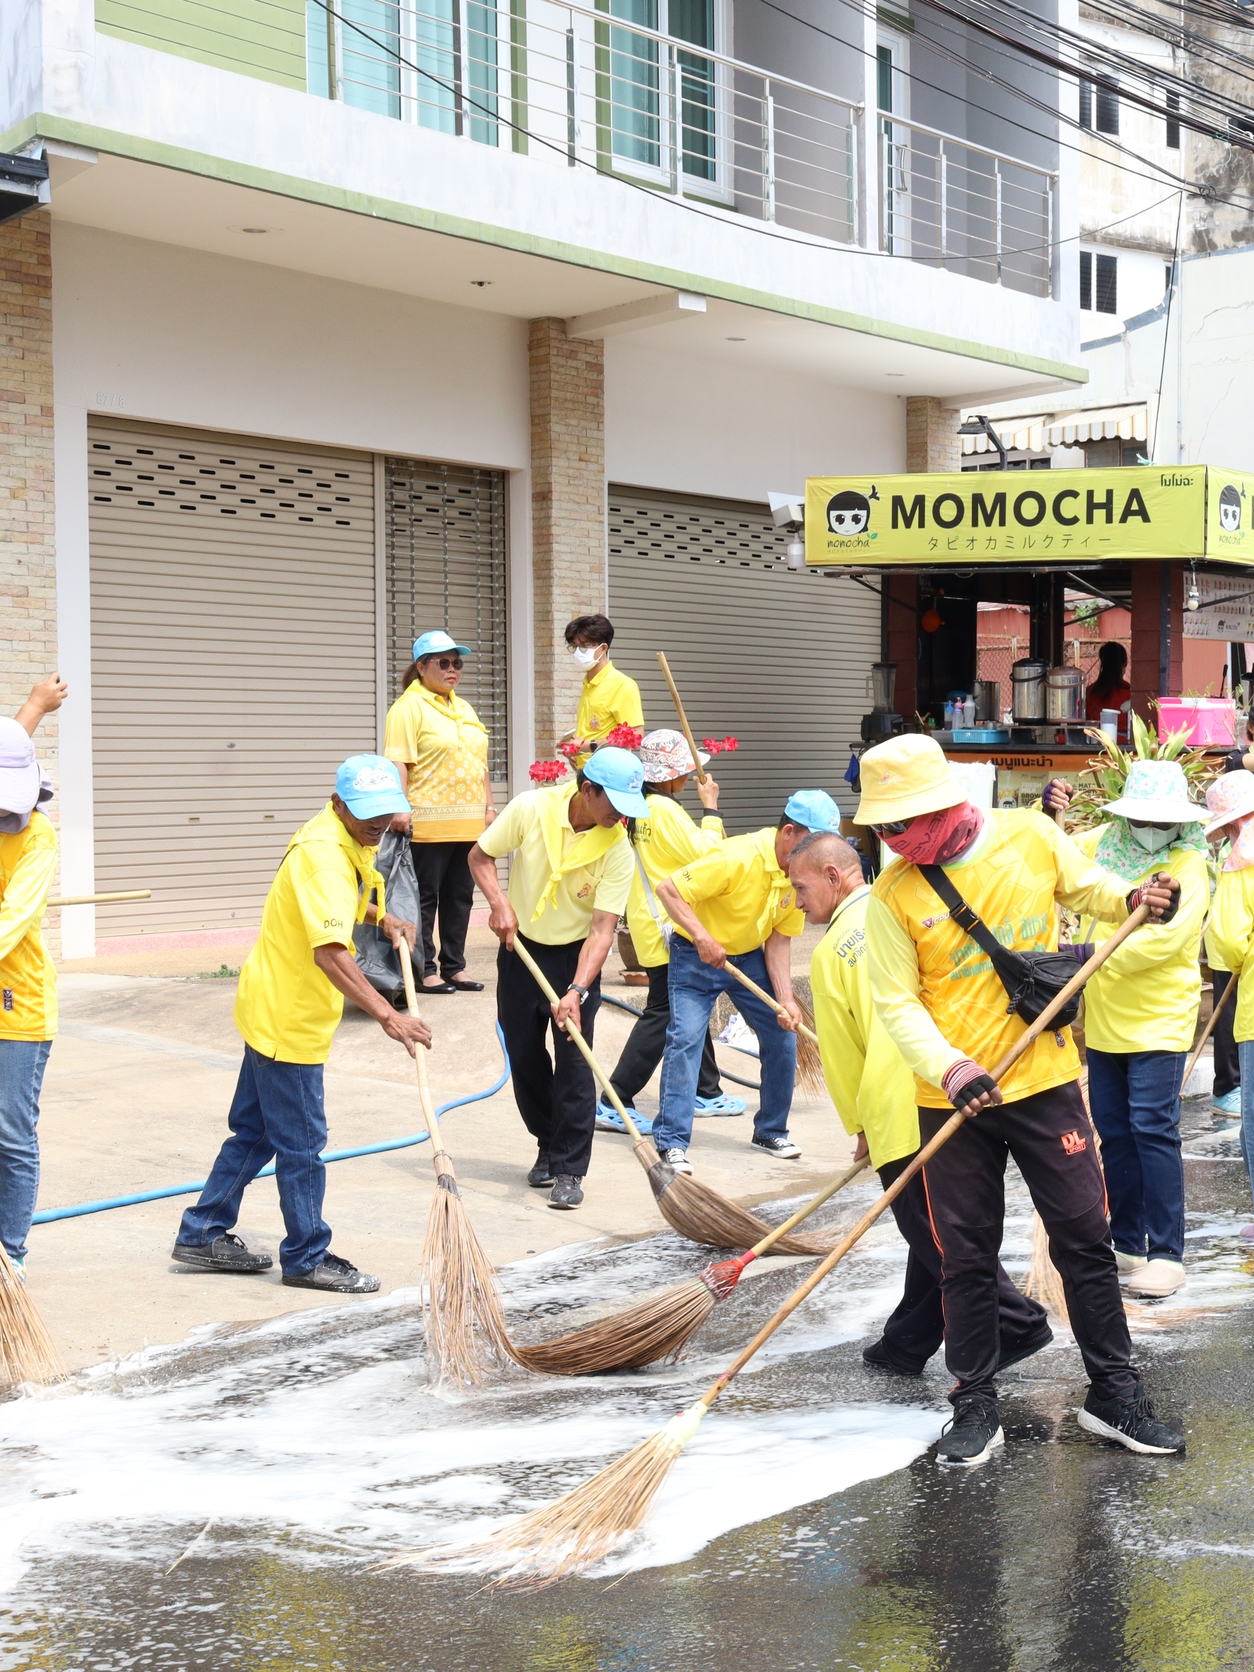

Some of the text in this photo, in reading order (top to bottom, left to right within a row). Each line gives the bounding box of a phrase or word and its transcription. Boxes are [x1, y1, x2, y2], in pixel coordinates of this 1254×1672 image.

[1160, 473, 1194, 487] โมโม่ฉะ
[891, 488, 1152, 529] MOMOCHA
[827, 537, 870, 548] momocha
[927, 534, 1111, 551] タピオカミルクティー
[324, 918, 344, 929] DOH
